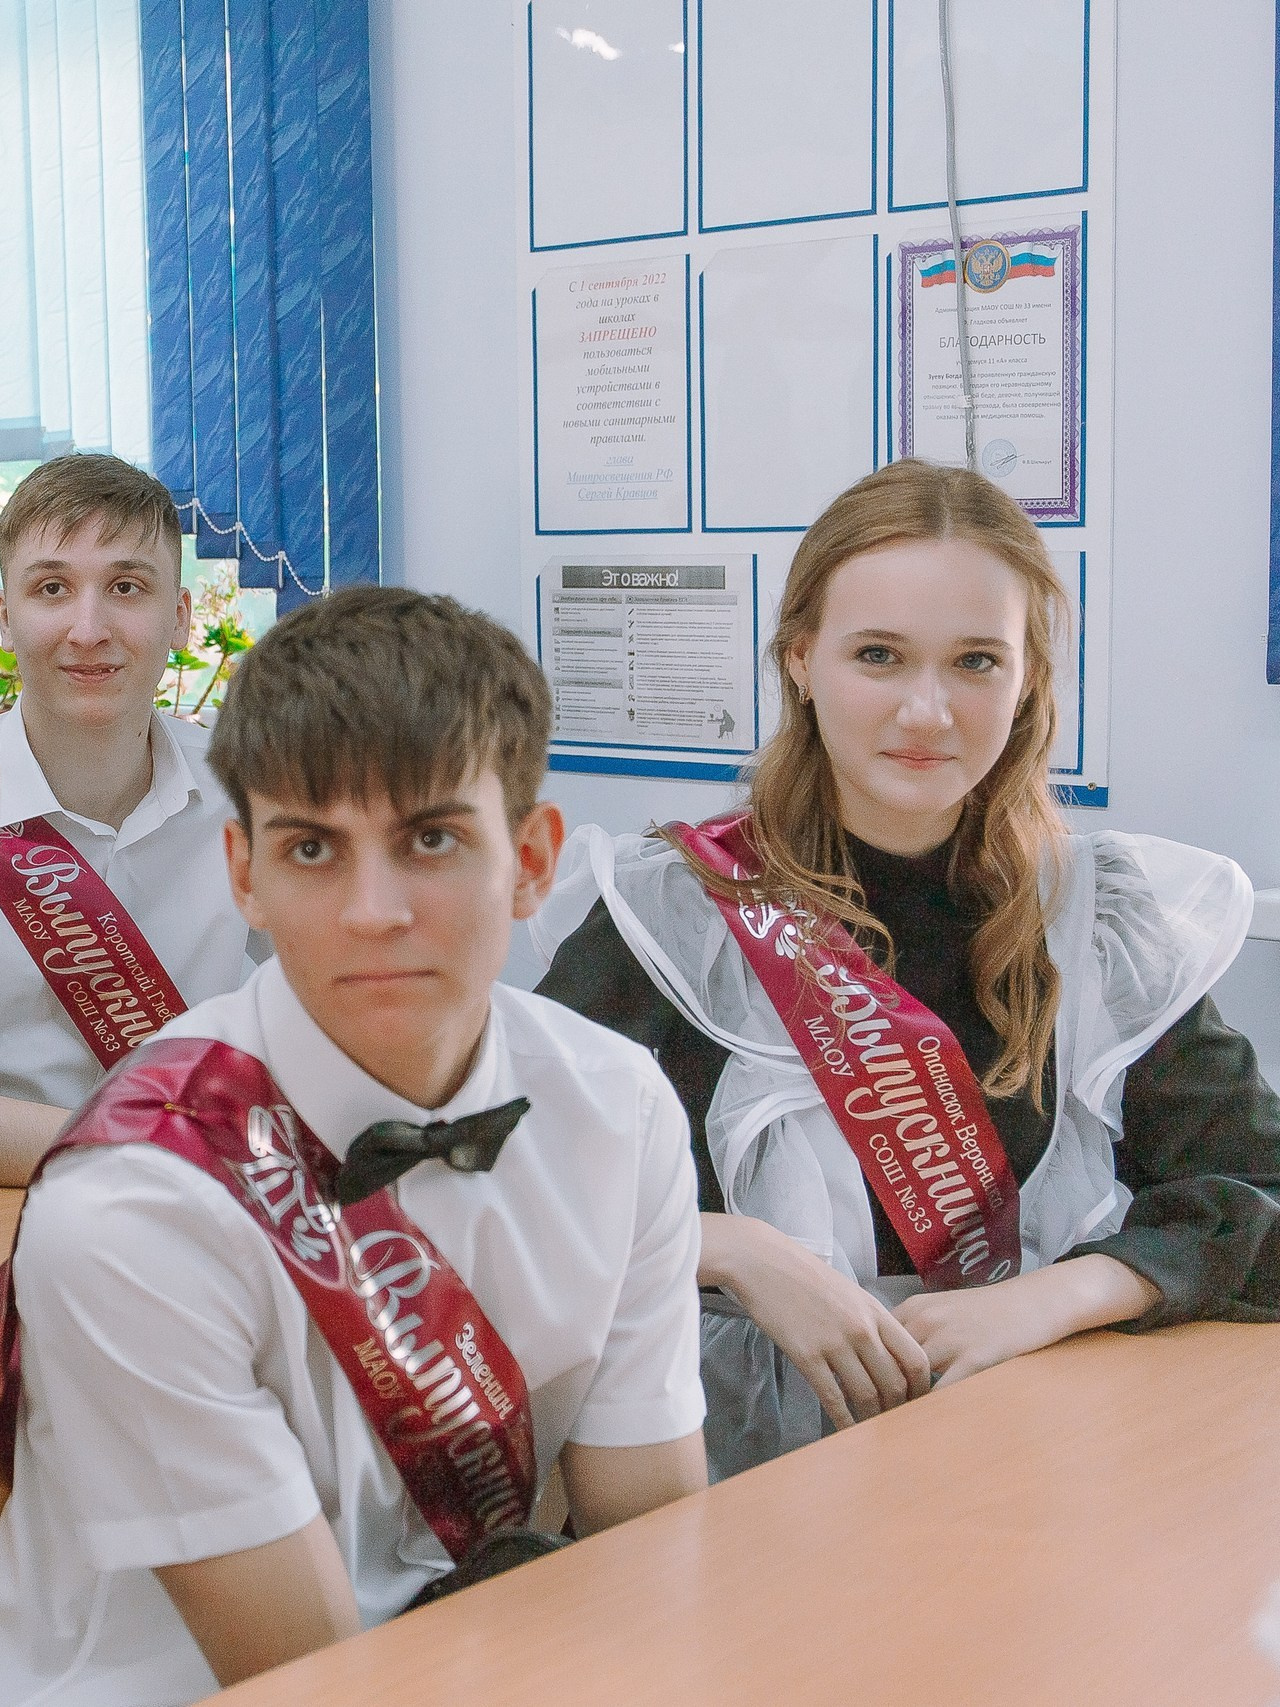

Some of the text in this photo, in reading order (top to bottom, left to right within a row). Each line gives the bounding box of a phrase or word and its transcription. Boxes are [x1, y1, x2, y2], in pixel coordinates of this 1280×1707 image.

[568, 272, 667, 294] С 1 сентября 2022
[575, 293, 660, 309] года на уроках в
[1000, 303, 1014, 311] СОШ
[598, 313, 636, 325] школах
[579, 326, 657, 343] ЗАПРЕЩЕНО
[583, 346, 653, 360] пользоваться
[585, 363, 650, 377] мобильными
[576, 380, 661, 396] устройствами в
[576, 398, 661, 412] соответствии с
[562, 414, 676, 430] новыми санитарными
[590, 433, 647, 449] правилами.
[655, 468, 674, 483] РФ
[578, 487, 659, 501] Сергей Кравцов
[632, 569, 679, 587] важно!
[96, 911, 157, 993] Короткий
[12, 897, 121, 1052] МАОУ СОШ №33
[917, 1035, 963, 1128] Опанасюк
[803, 1014, 933, 1235] МАОУ СОШ №33
[454, 1322, 514, 1421] Зеленин
